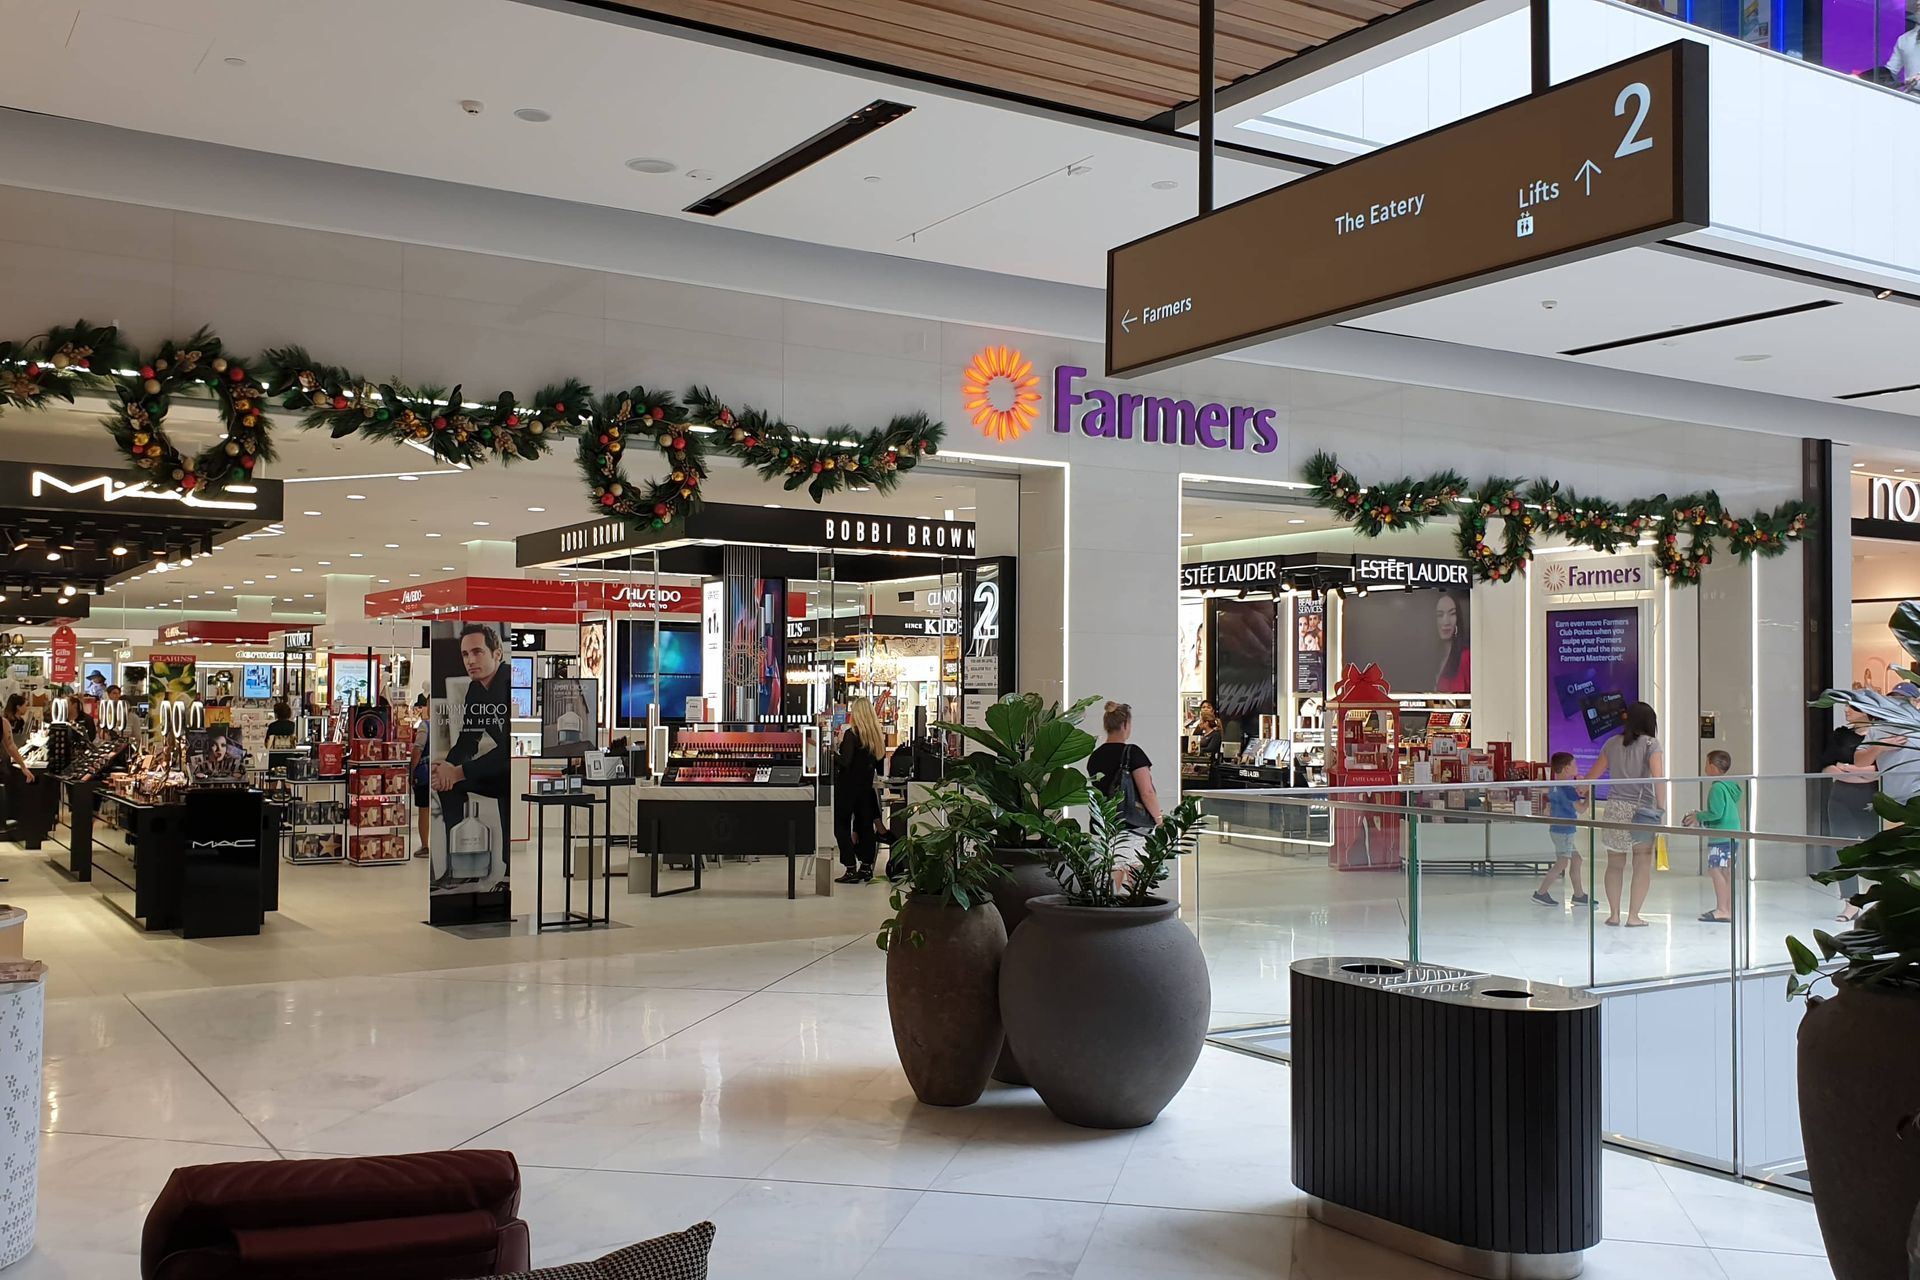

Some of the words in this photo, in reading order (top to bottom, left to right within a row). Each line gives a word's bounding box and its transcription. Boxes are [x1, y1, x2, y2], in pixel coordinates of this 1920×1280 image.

[1614, 82, 1653, 159] 2
[1518, 178, 1560, 210] Lifts
[1335, 212, 1365, 236] The
[1370, 192, 1426, 229] Eatery
[1142, 297, 1193, 325] Farmers
[1053, 364, 1279, 454] Farmers
[561, 529, 588, 552] BOBBI
[593, 521, 625, 546] BROWN
[826, 519, 891, 544] BOBBI
[908, 525, 975, 549] BROWN
[1219, 561, 1276, 584] LAUDER
[1409, 563, 1469, 584] LAUDER
[1568, 566, 1641, 587] Farmers
[611, 587, 681, 602] SHISEIDO
[1555, 620, 1569, 628] Earn
[1612, 628, 1624, 636] you
[436, 703, 468, 716] JIMMY
[470, 703, 508, 716] CHOO
[478, 717, 506, 725] HERO
[192, 839, 256, 849] MAC
